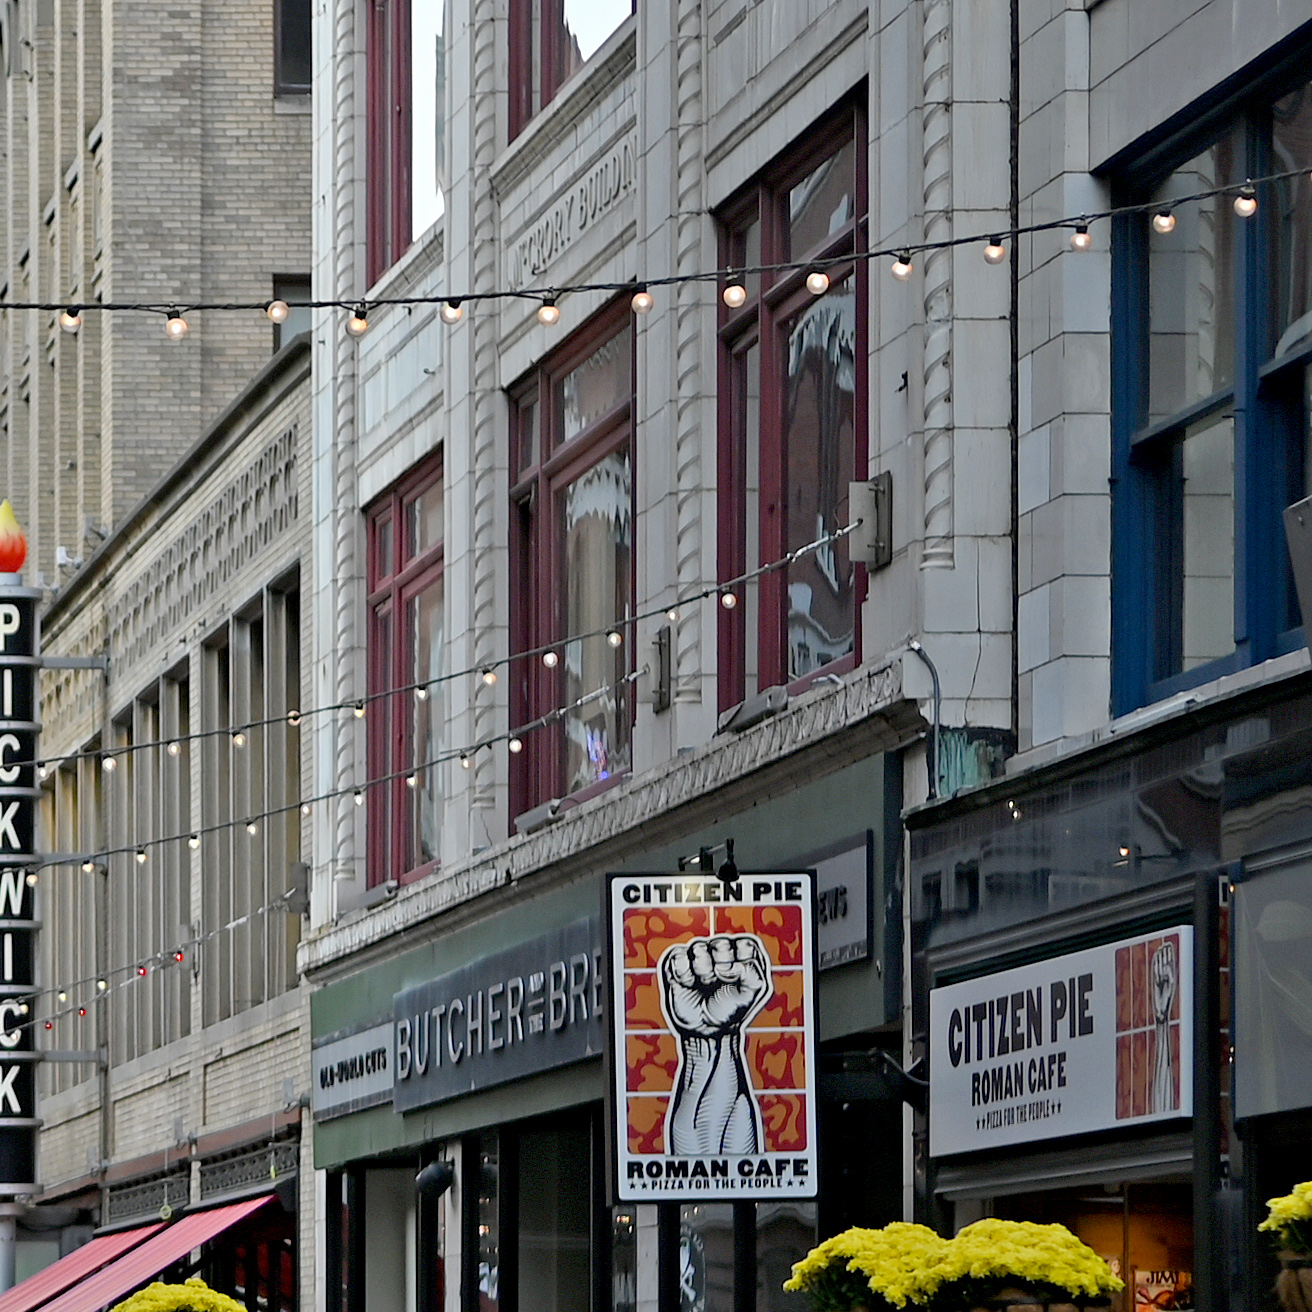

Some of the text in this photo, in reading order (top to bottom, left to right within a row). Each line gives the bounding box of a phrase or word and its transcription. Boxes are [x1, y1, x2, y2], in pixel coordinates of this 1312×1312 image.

[579, 134, 637, 230] BUILDIN
[622, 881, 803, 903] CITIZEN PIE
[397, 946, 603, 1081] BUTCHER BRE
[528, 1012, 545, 1034] THE
[948, 972, 1094, 1068] CITIZEN PIE
[366, 1047, 387, 1074] CUTS
[971, 1051, 1067, 1107] ROMAN CAFE
[986, 1099, 1050, 1131] PIZZA FOR THE PEOPLE
[626, 1158, 809, 1179] ROMAN CAFE
[651, 1178, 782, 1190] PIZZA FOR THE PEOPLE
